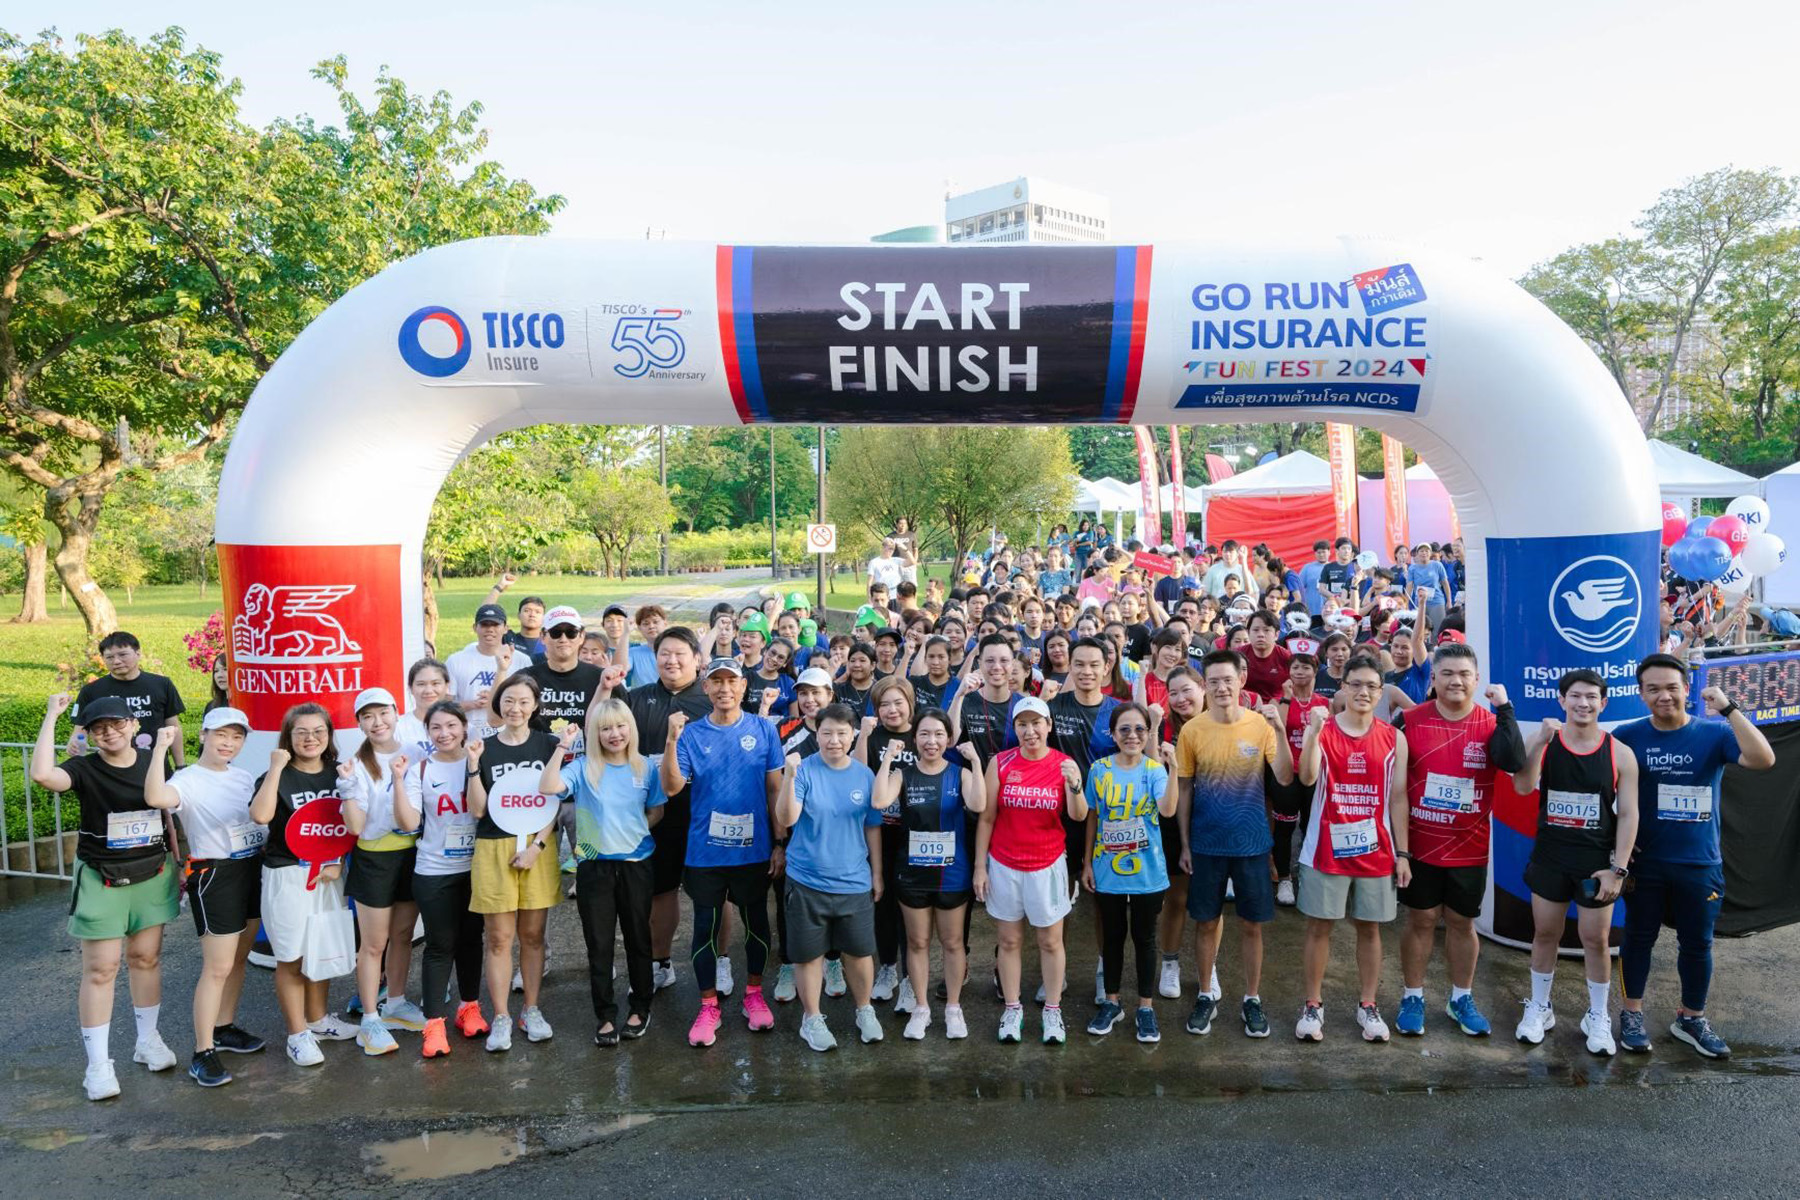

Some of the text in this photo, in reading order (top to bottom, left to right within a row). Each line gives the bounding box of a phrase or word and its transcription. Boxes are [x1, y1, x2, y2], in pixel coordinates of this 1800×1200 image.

[1191, 281, 1349, 312] GO RUN
[602, 304, 647, 315] TISCO's
[837, 282, 1030, 332] START
[482, 312, 565, 349] TISCO
[1191, 317, 1427, 350] INSURANCE
[611, 309, 685, 378] 55
[487, 352, 539, 371] Insure
[829, 344, 1039, 393] FINISH
[1203, 359, 1405, 378] FUN FEST 2024
[648, 369, 706, 381] Anniversary
[1354, 392, 1399, 405] NCDs
[1720, 568, 1744, 585] BKI
[234, 667, 363, 694] GENERALI
[1756, 708, 1777, 720] RACE
[1646, 752, 1693, 766] indigo
[1003, 785, 1059, 798] GENERALI
[1333, 784, 1378, 795] GENERALI
[1438, 786, 1461, 800] 183
[501, 795, 546, 808] ERGO
[1002, 796, 1059, 810] THAILAND
[1673, 797, 1697, 809] 111
[1336, 804, 1376, 816] JOURNEY
[1411, 806, 1456, 824] JOURNEY
[1548, 801, 1597, 817] 0901/5
[123, 822, 149, 835] 167
[299, 822, 348, 837] ERGO
[721, 825, 744, 837] 132
[1103, 828, 1146, 843] 0602/3
[242, 832, 264, 846] 128
[1344, 832, 1368, 845] 176
[920, 843, 944, 854] 019
